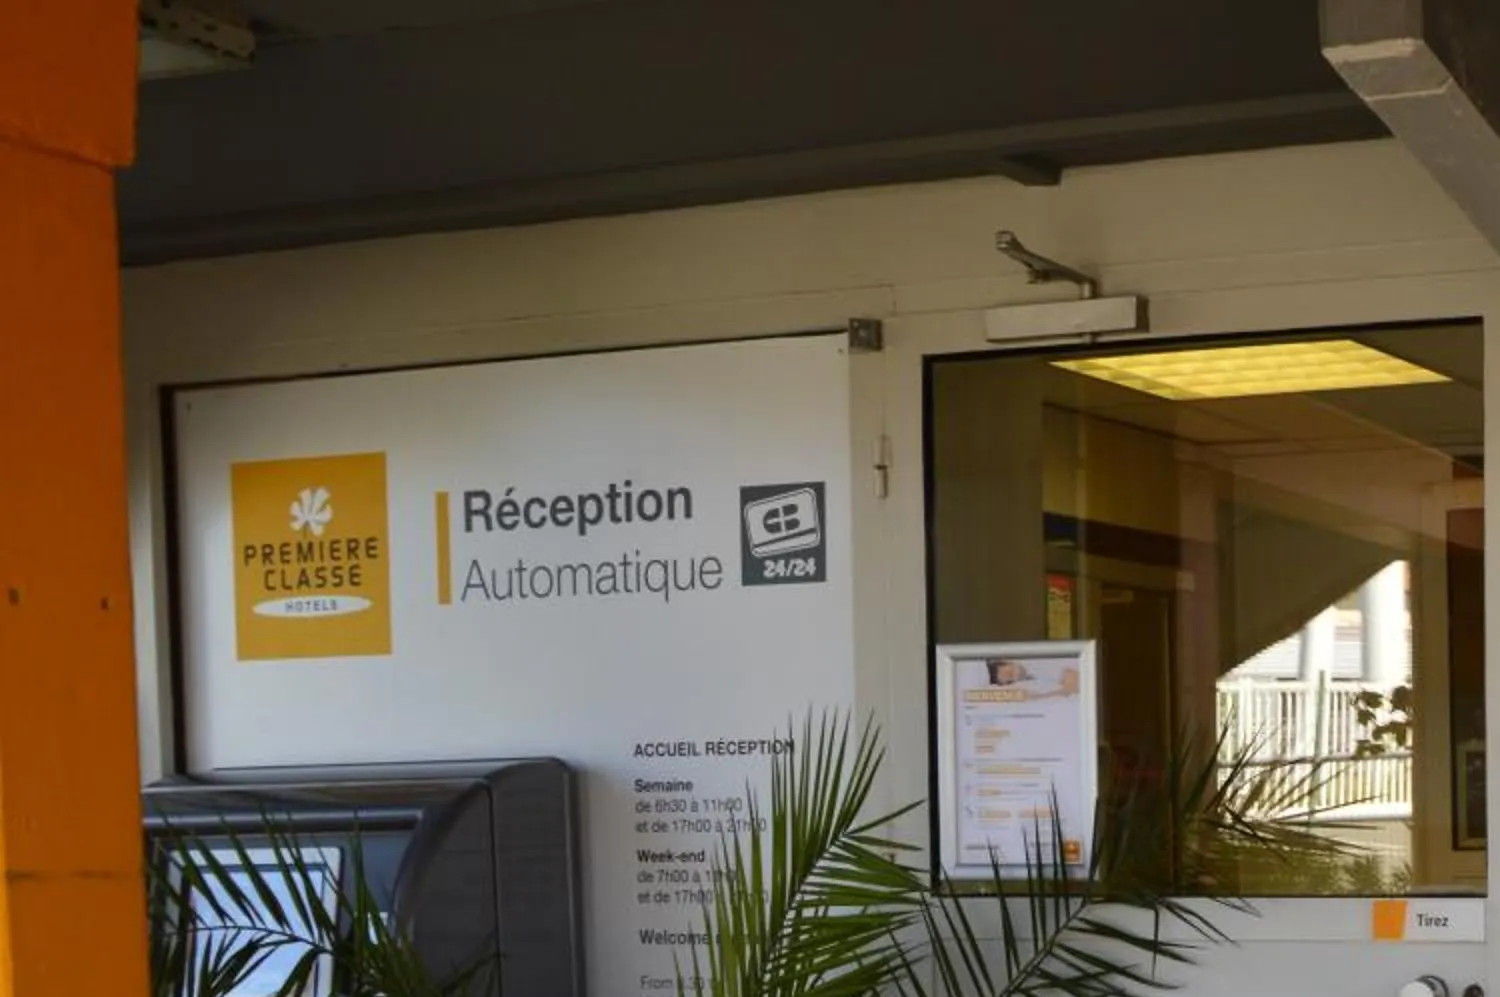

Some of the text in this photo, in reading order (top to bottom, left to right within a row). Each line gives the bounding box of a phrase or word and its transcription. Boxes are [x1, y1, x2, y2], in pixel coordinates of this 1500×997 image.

[463, 479, 693, 536] Réception
[243, 537, 378, 567] PREMIERE
[763, 557, 816, 578] 24/24
[264, 565, 361, 590] CLASSE
[461, 548, 723, 604] Automatique
[285, 599, 337, 613] HOTELS
[633, 737, 795, 758] ACCUEIL RÉCEPTION
[634, 778, 693, 792] Semaine
[636, 800, 651, 813] de
[653, 819, 669, 833] de
[673, 818, 712, 833] 17h00
[638, 849, 705, 863] Week-end
[637, 869, 653, 883] de
[653, 890, 670, 904] de
[1416, 914, 1449, 928] Tirez
